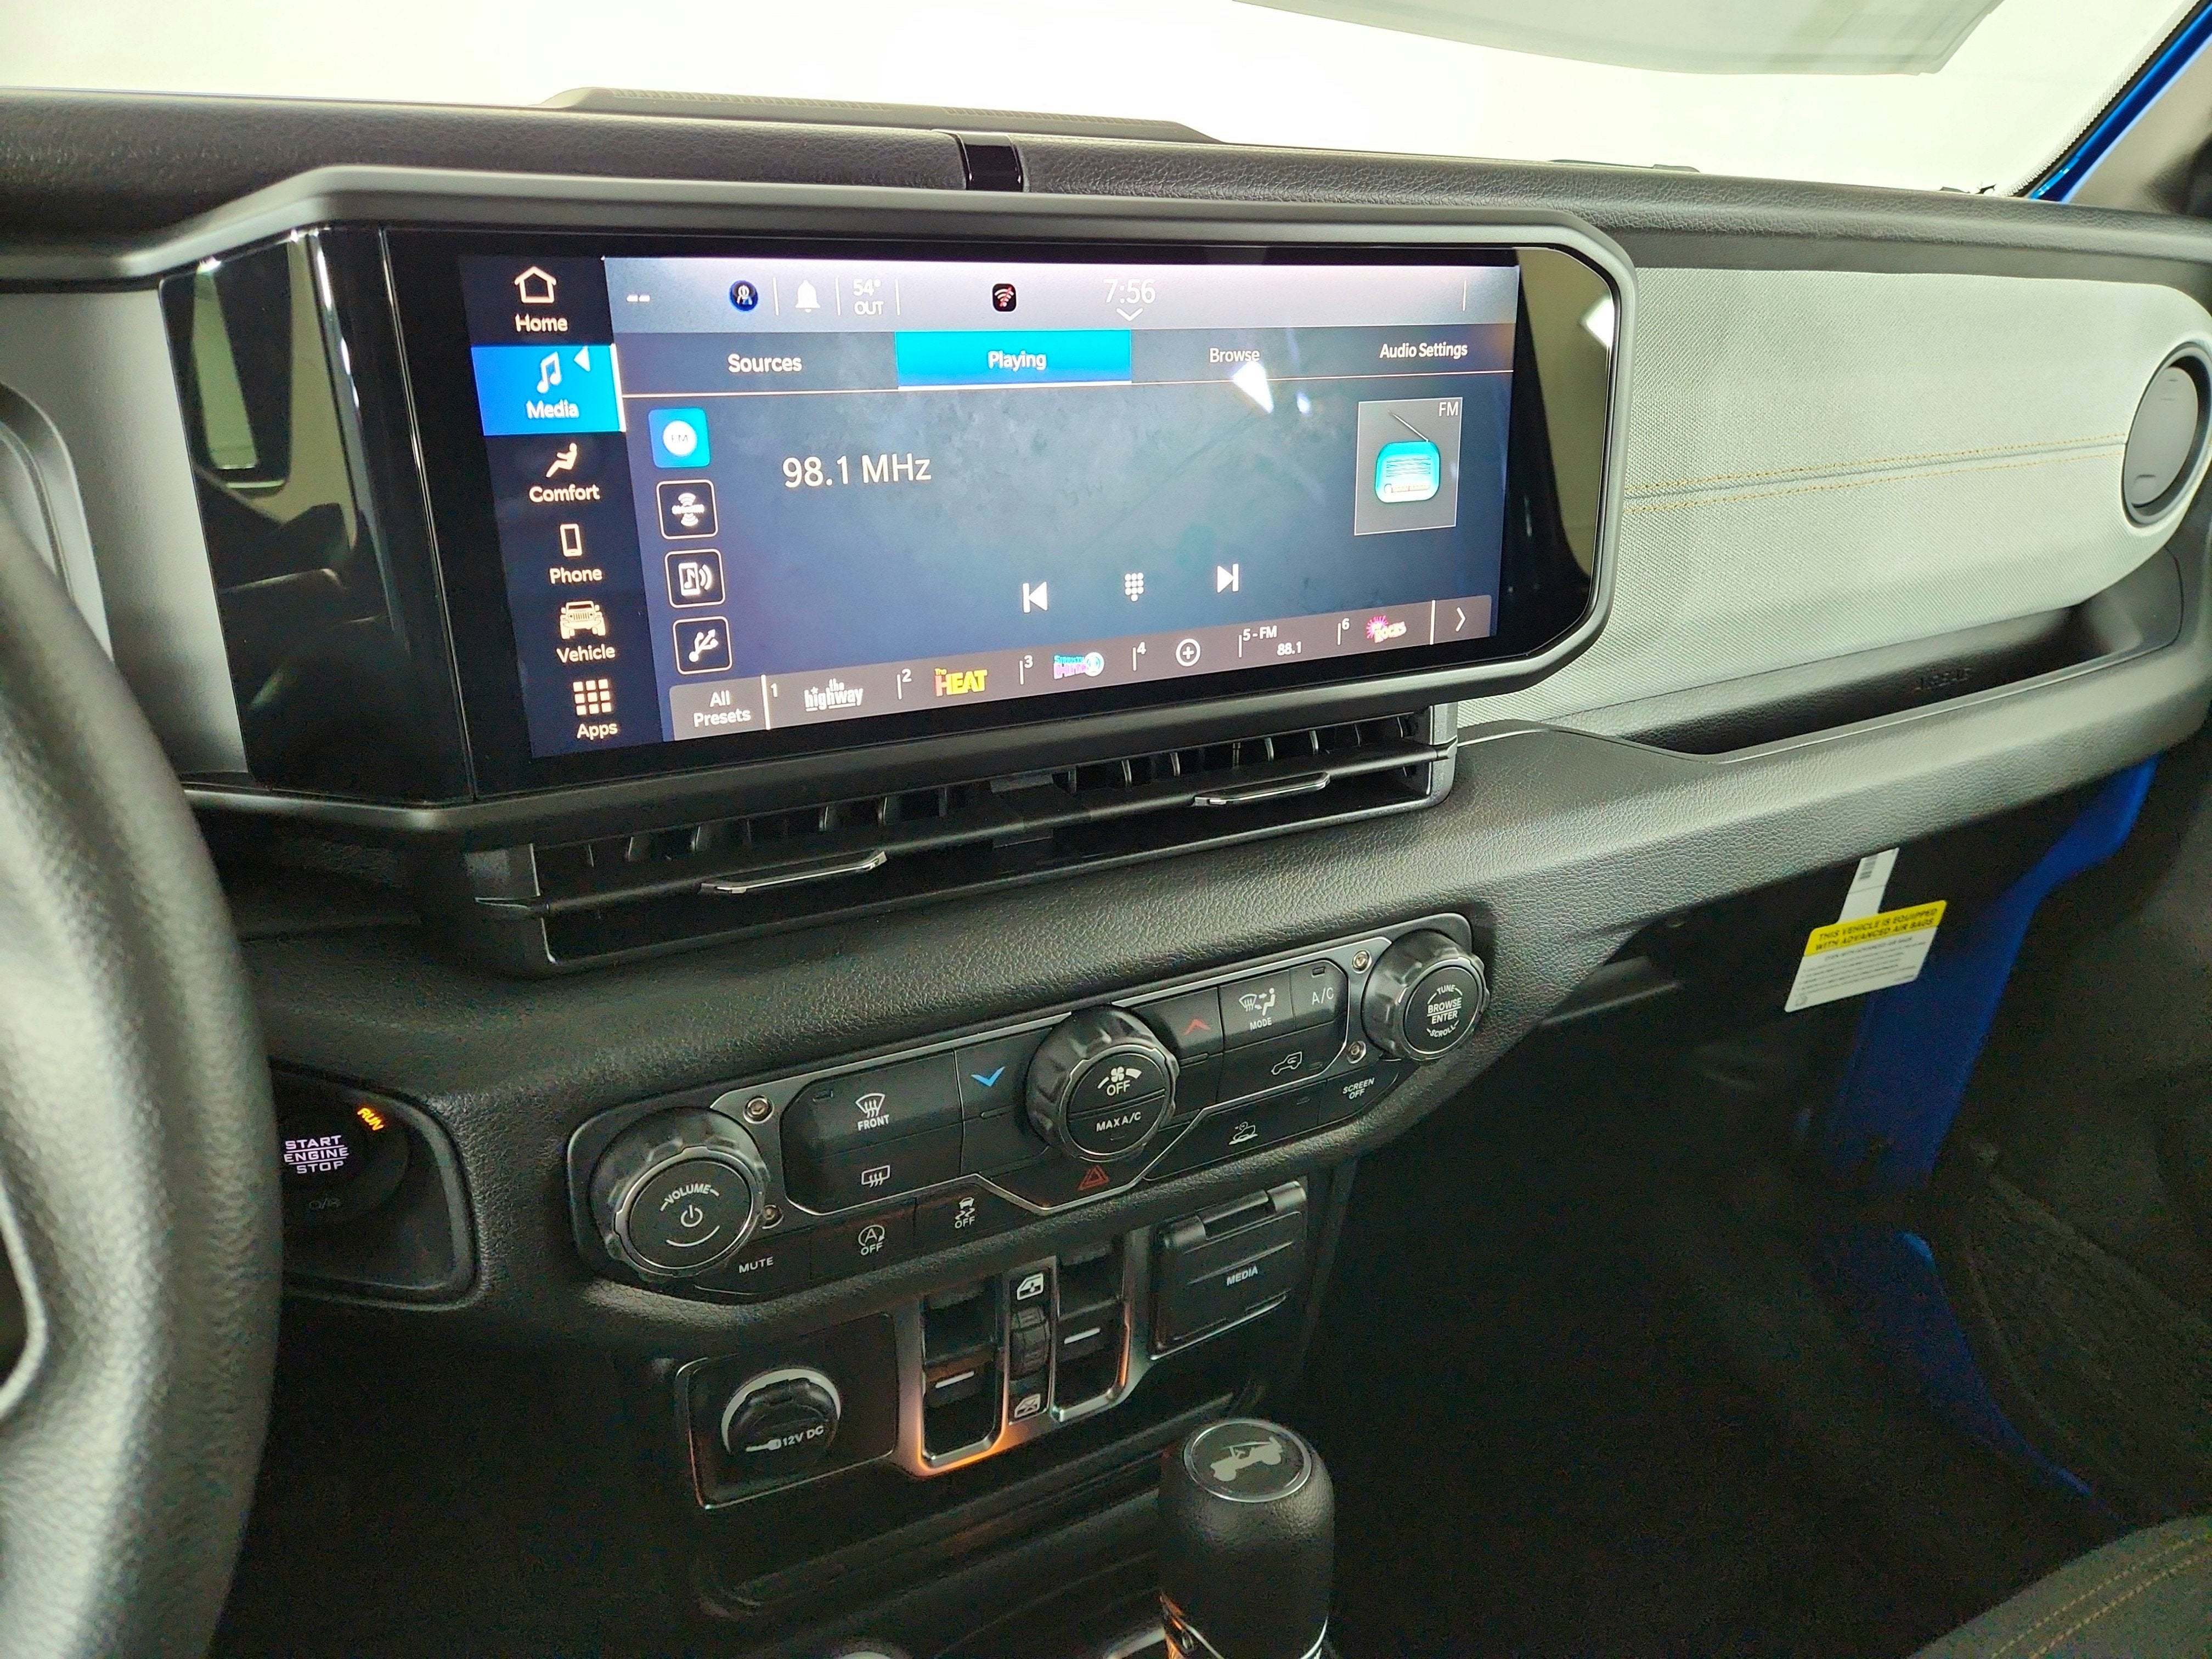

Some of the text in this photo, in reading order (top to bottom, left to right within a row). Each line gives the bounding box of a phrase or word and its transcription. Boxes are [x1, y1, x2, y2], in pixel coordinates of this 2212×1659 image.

[1103, 278, 1155, 304] 7:56
[854, 301, 884, 315] OUT
[515, 314, 568, 332] Home
[1209, 348, 1260, 363] Browse
[1380, 342, 1468, 359] Audio Settings
[728, 353, 802, 373] Sources
[988, 350, 1047, 371] Playing
[526, 400, 579, 419] Media
[1438, 402, 1459, 417] FM
[782, 453, 932, 488] 98.1 MHz
[529, 486, 600, 503] Comfort
[549, 567, 603, 584] Phone
[1341, 618, 1350, 630] 6
[556, 644, 616, 663] Vehicle
[1137, 642, 1147, 655] 4
[1277, 641, 1302, 656] 88.1
[1024, 655, 1033, 669] 3
[902, 669, 912, 683] 2
[935, 669, 988, 697] HEAT
[770, 682, 778, 697] 1
[829, 678, 845, 692] the
[709, 690, 730, 707] All
[804, 687, 864, 711] highway
[693, 709, 751, 727] Presets
[577, 721, 618, 740] Apps
[1311, 987, 1334, 1005] A/C
[1437, 984, 1456, 995] TUNE
[1427, 997, 1462, 1013] BROWSE
[1250, 1017, 1272, 1031] MODE
[1431, 1011, 1458, 1025] ENTER
[1429, 1025, 1457, 1038] SCROLL
[1107, 1080, 1131, 1097] OFF
[1342, 1077, 1375, 1094] SCREEN
[1348, 1088, 1365, 1100] OFF
[357, 1108, 384, 1131] RUN
[857, 1114, 890, 1131] FRONT
[1096, 1111, 1142, 1132] MAX A/C
[285, 1135, 342, 1150] START
[284, 1147, 349, 1163] ENGINE
[297, 1160, 344, 1174] STOP
[664, 1183, 712, 1205] VOLUME
[955, 1216, 975, 1229] OFF
[860, 1242, 883, 1256] OFF
[738, 1256, 774, 1274] MUTE
[1226, 1265, 1259, 1286] MEDIA
[782, 1425, 824, 1447] 12V DC
